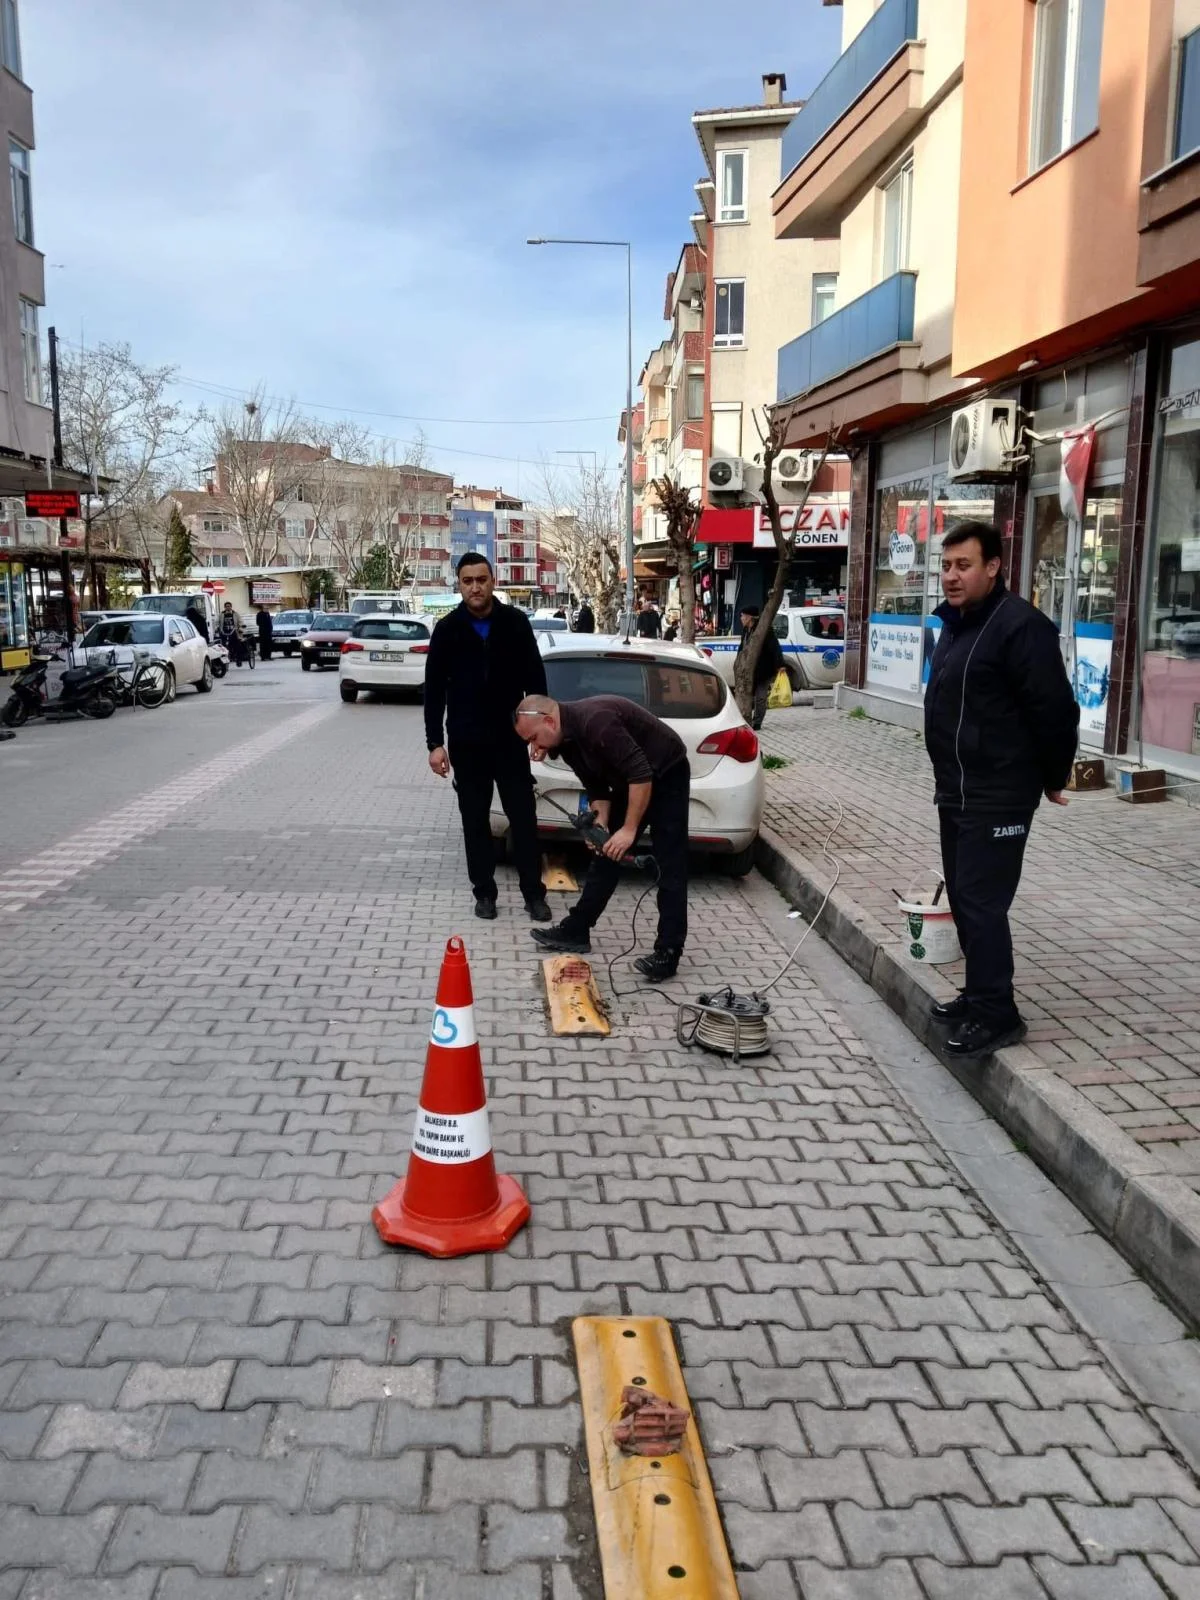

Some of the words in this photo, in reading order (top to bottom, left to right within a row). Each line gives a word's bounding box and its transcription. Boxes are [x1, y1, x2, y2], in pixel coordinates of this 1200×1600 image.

[794, 531, 838, 544] GÖNEN
[993, 825, 1025, 838] ZABITA
[440, 1134, 457, 1143] BAKIM
[457, 1134, 465, 1143] VE
[440, 1148, 471, 1159] BAŞKANLIĞI
